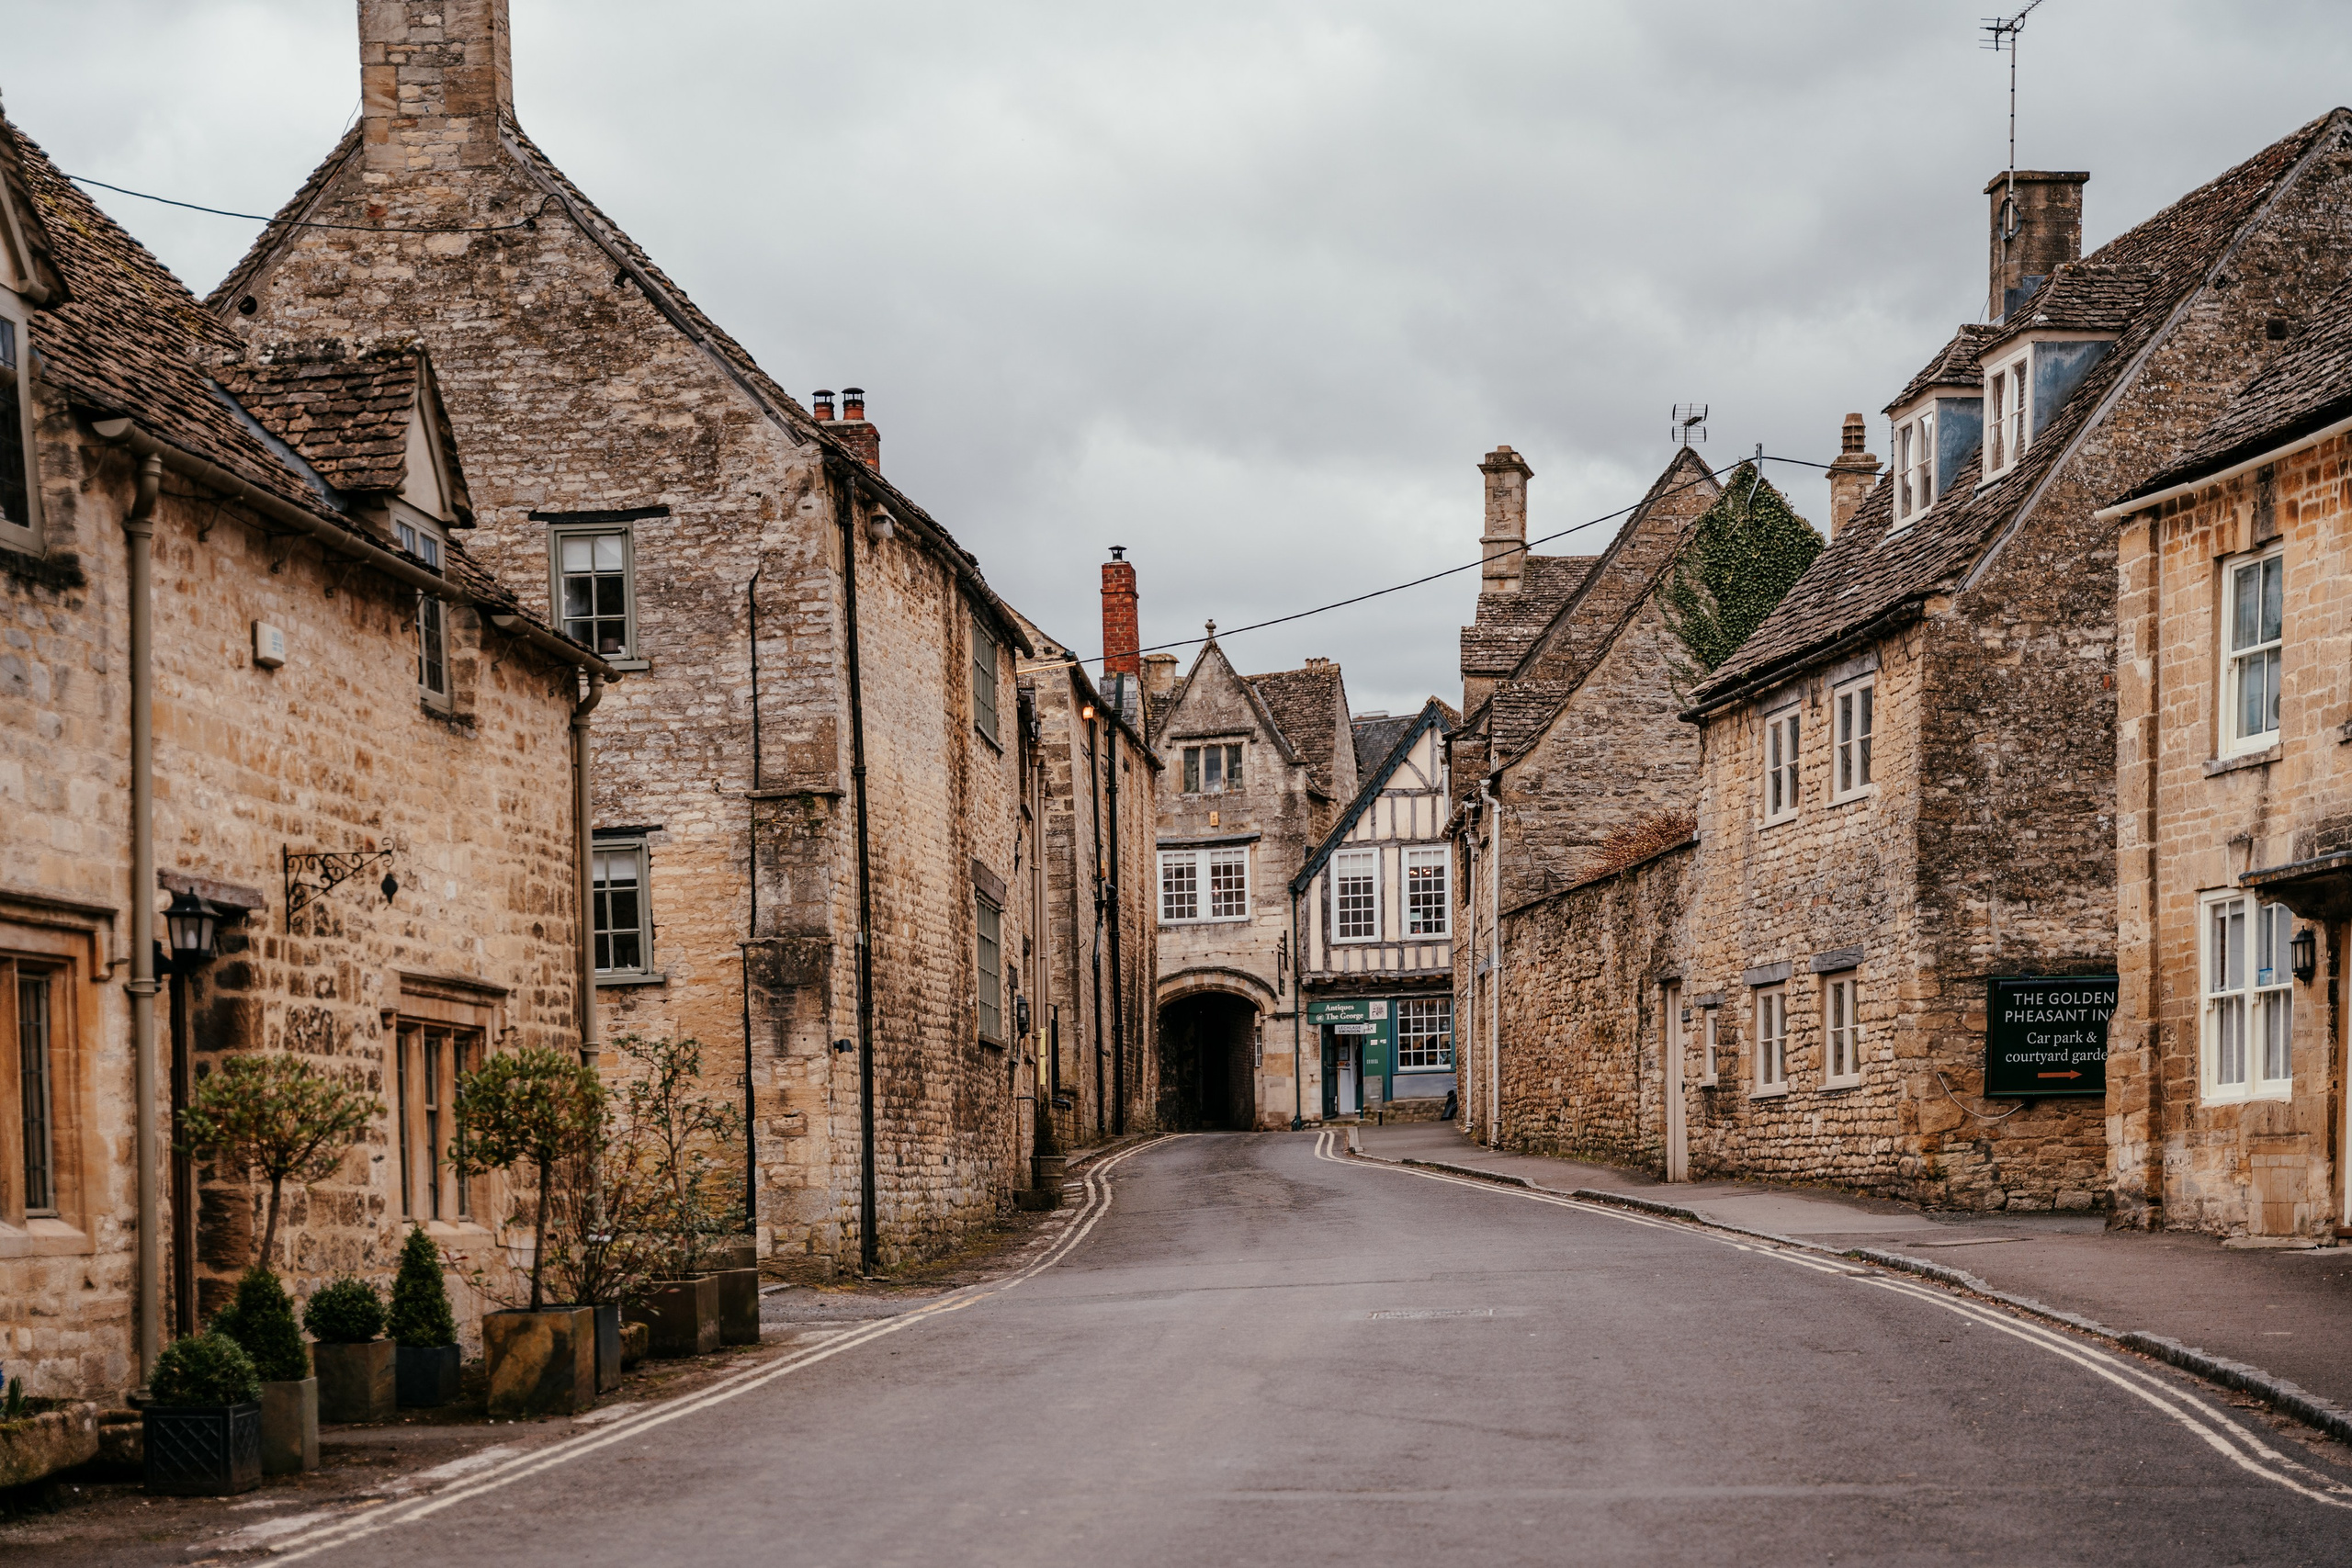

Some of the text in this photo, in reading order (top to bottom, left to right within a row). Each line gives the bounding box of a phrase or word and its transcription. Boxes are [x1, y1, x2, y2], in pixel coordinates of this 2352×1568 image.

[2013, 992, 2115, 1006] THE GOLDEN
[1325, 1004, 1354, 1012] Antiques
[1316, 1012, 1363, 1021] @ The George
[2005, 1009, 2114, 1022] PHEASANT IN
[2027, 1031, 2098, 1046] Car park &
[2293, 1029, 2312, 1038] COTTAGE
[2006, 1048, 2108, 1065] courtyard garde
